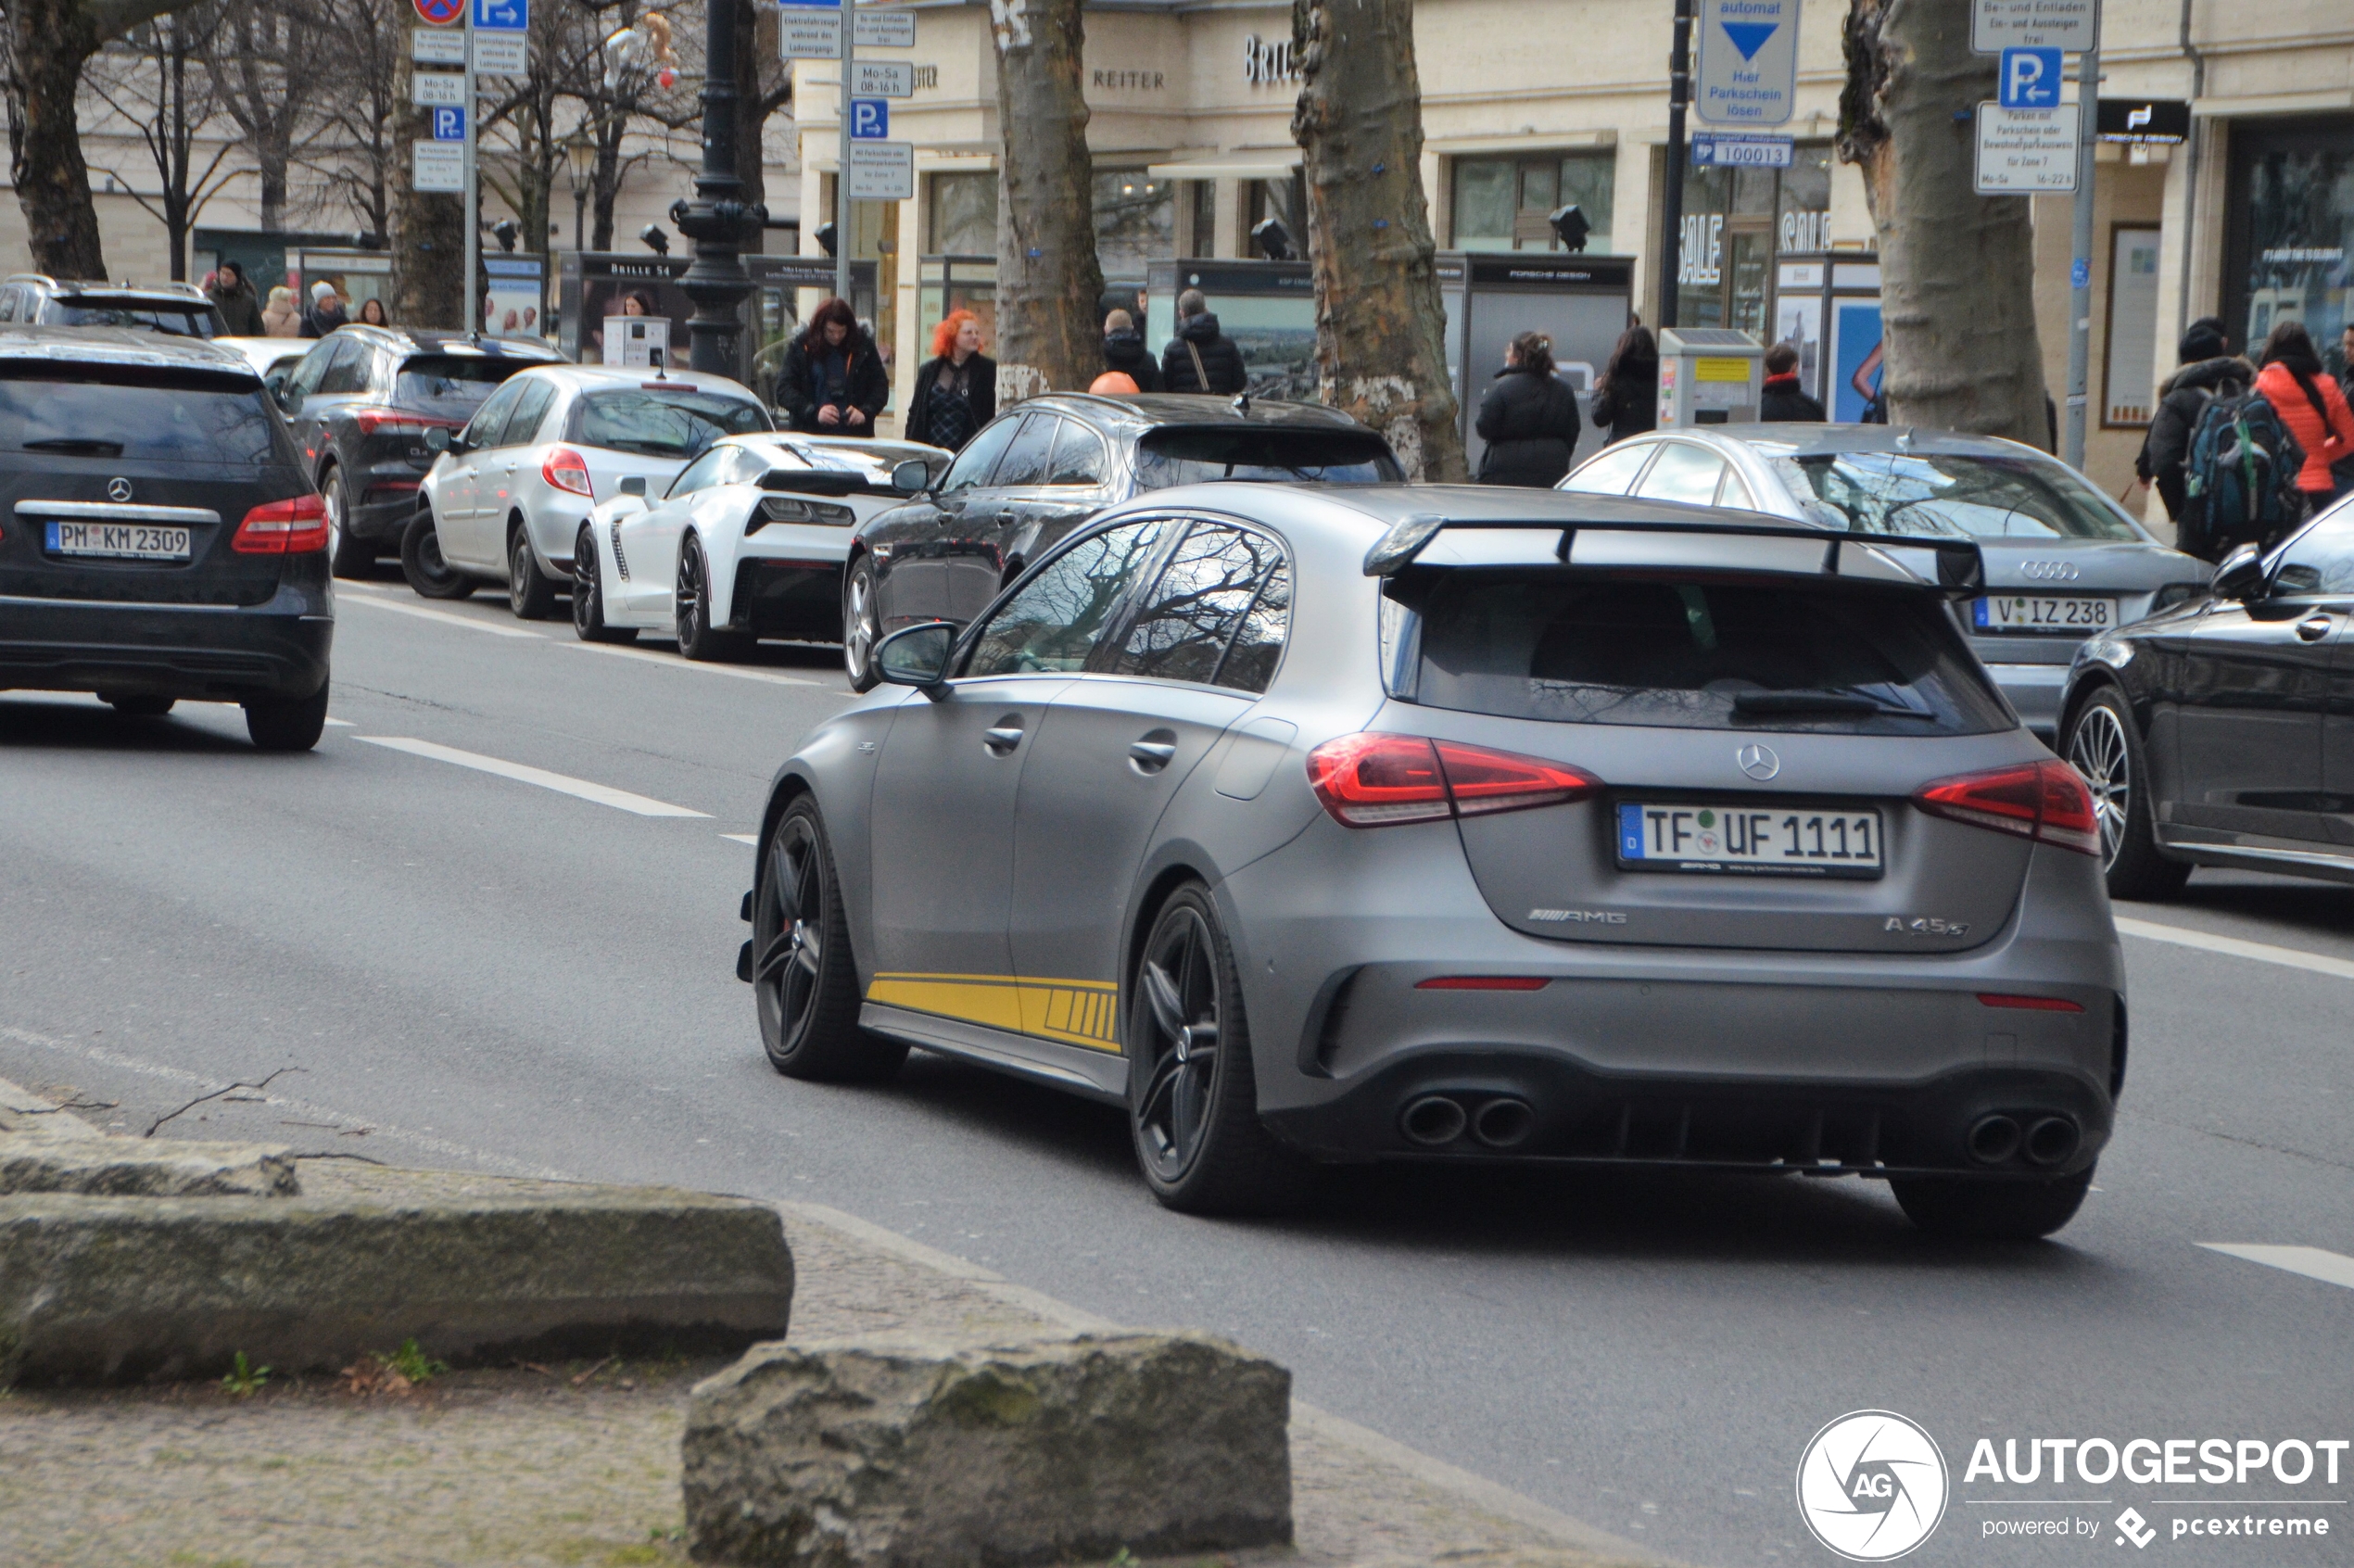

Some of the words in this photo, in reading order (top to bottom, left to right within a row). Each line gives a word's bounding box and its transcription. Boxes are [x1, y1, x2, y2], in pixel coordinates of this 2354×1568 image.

[1720, 2, 1781, 15] automat
[2009, 2, 2031, 12] und
[2036, 1, 2086, 12] Entladen
[2012, 18, 2028, 28] und
[2032, 18, 2079, 30] Aussteigen
[2024, 32, 2044, 44] frei
[1244, 34, 1302, 82] BRIL
[863, 68, 899, 80] Mo-Sa
[913, 65, 938, 90] EITER
[1094, 69, 1165, 89] REITER
[1733, 70, 1760, 82] Hier
[424, 78, 454, 89] Mo-Sa
[892, 81, 900, 93] h
[1709, 86, 1781, 100] Parkschein
[1727, 104, 1762, 116] lösen
[2007, 110, 2036, 120] Parken
[2039, 110, 2051, 120] mit
[1996, 124, 2042, 135] Parkschein
[2044, 125, 2061, 134] oder
[1725, 146, 1783, 162] 100013
[2021, 156, 2040, 167] Zone
[611, 262, 651, 275] BRILLE
[656, 265, 670, 276] 54
[1510, 269, 1554, 278] PORSCHE
[1556, 271, 1591, 280] DESIGN
[60, 525, 88, 547] PM
[103, 526, 131, 550] KM
[136, 529, 187, 552] 2309
[1998, 600, 2012, 622] V
[2031, 601, 2059, 623] IZ
[2066, 602, 2107, 625] 238
[1647, 811, 1693, 853] TF
[1726, 814, 1770, 855] UF
[1783, 816, 1877, 860] 1111
[1627, 837, 1637, 850] D
[1560, 911, 1626, 924] AMG
[1885, 917, 1904, 931] A
